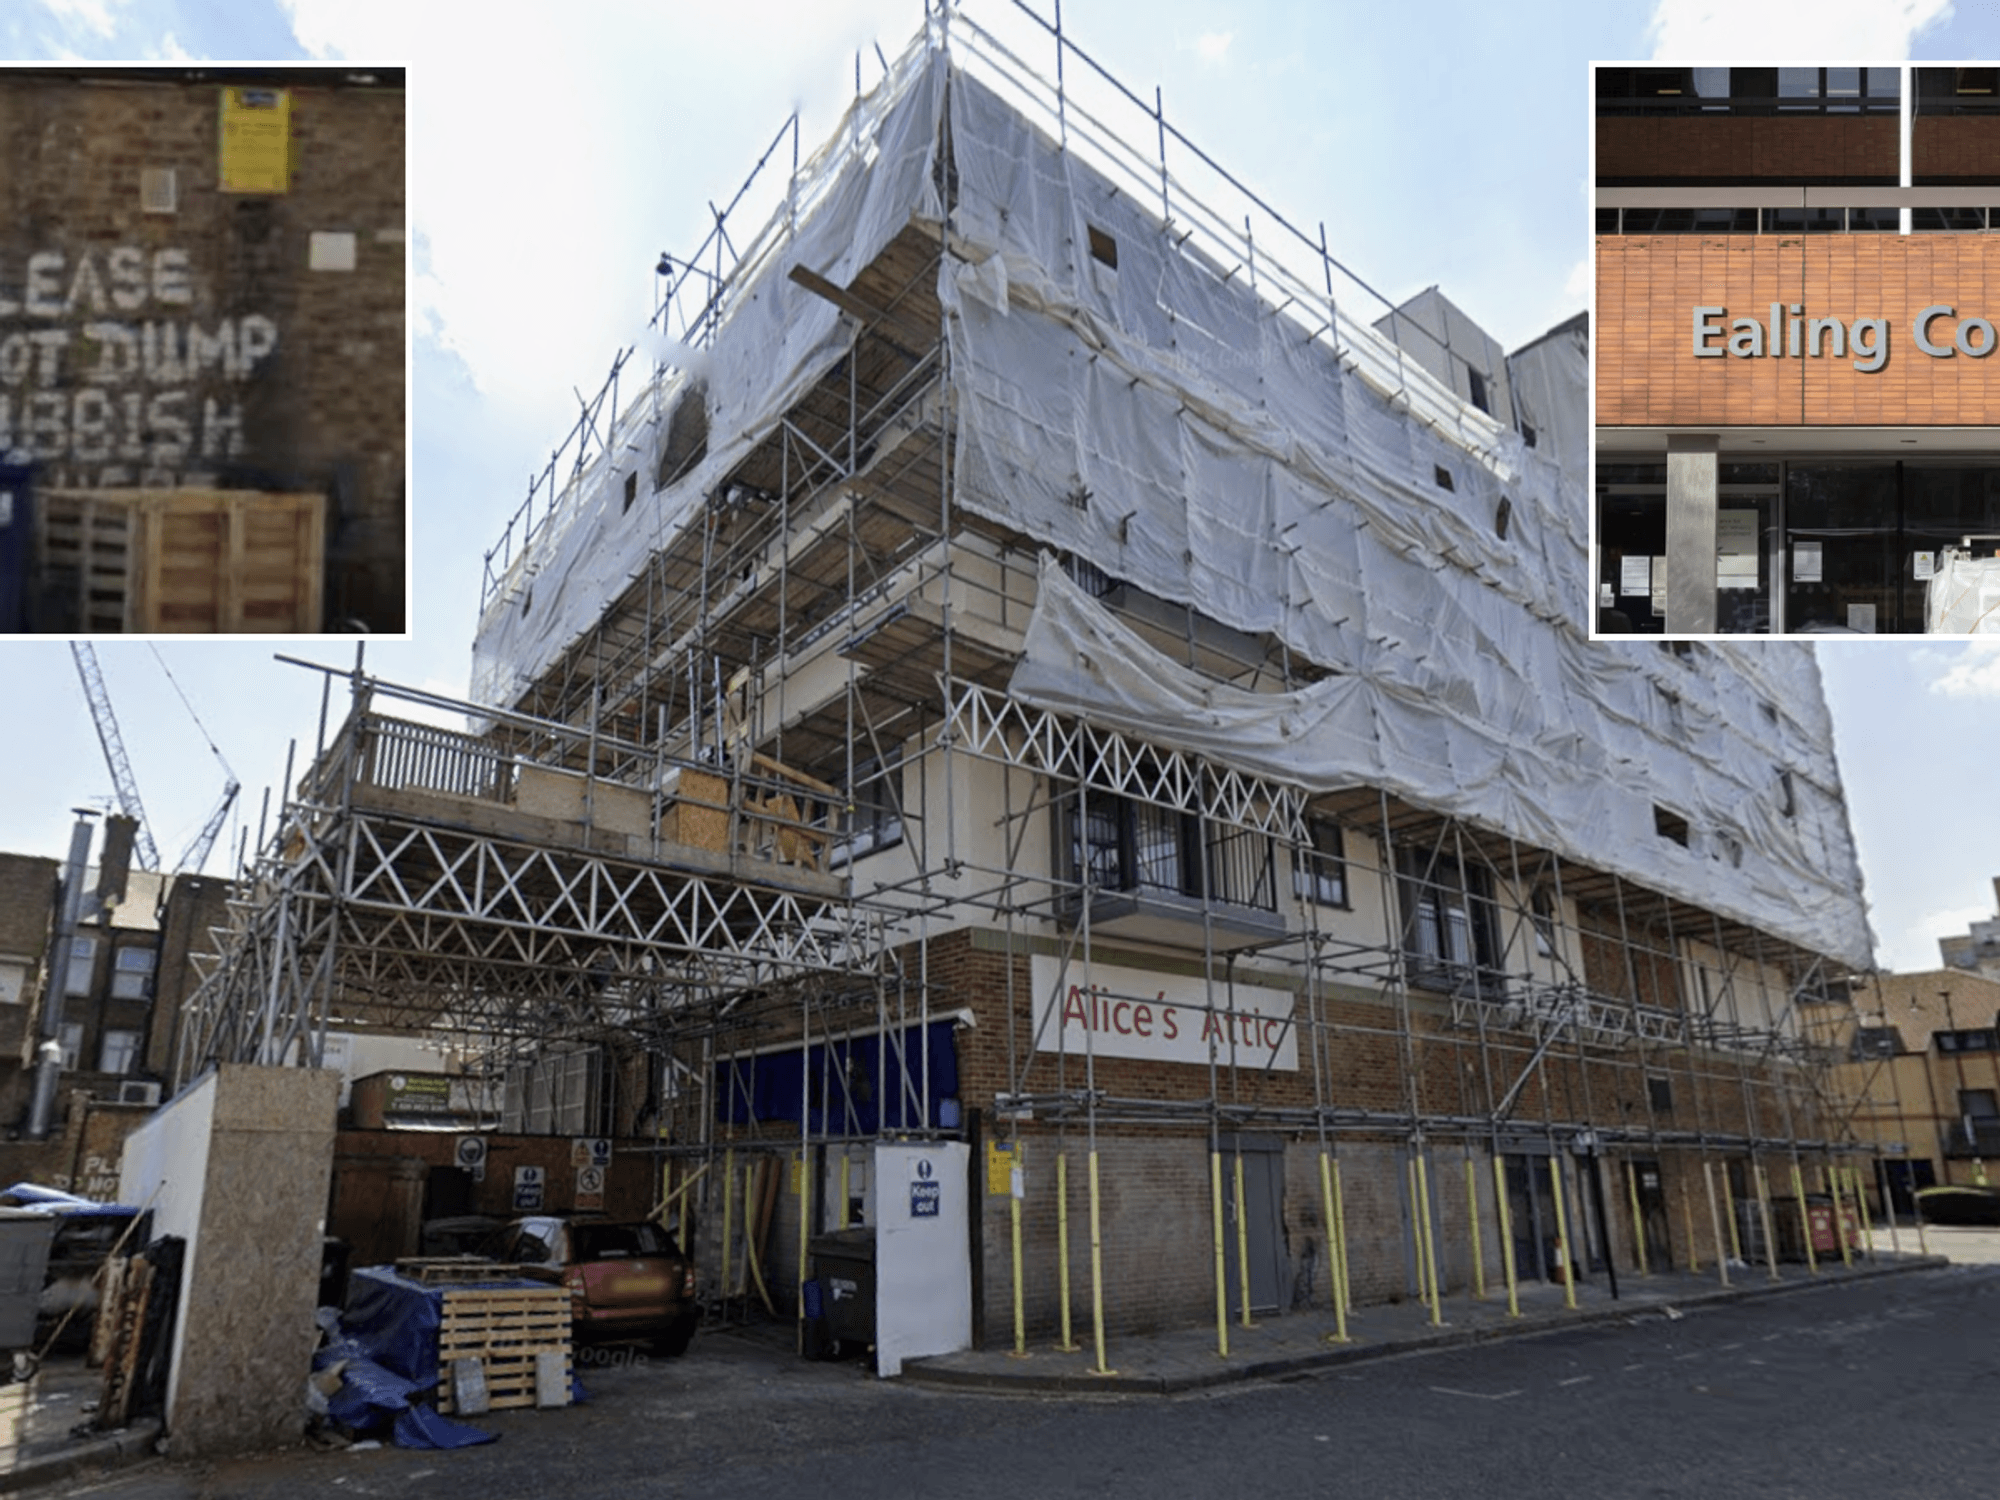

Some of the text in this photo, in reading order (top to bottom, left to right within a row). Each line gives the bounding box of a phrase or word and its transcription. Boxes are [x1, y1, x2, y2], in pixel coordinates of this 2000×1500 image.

[83, 314, 279, 383] DUMP
[1692, 302, 1887, 373] Ealing
[1064, 984, 1178, 1040] Alice's
[911, 1185, 940, 1200] Keep
